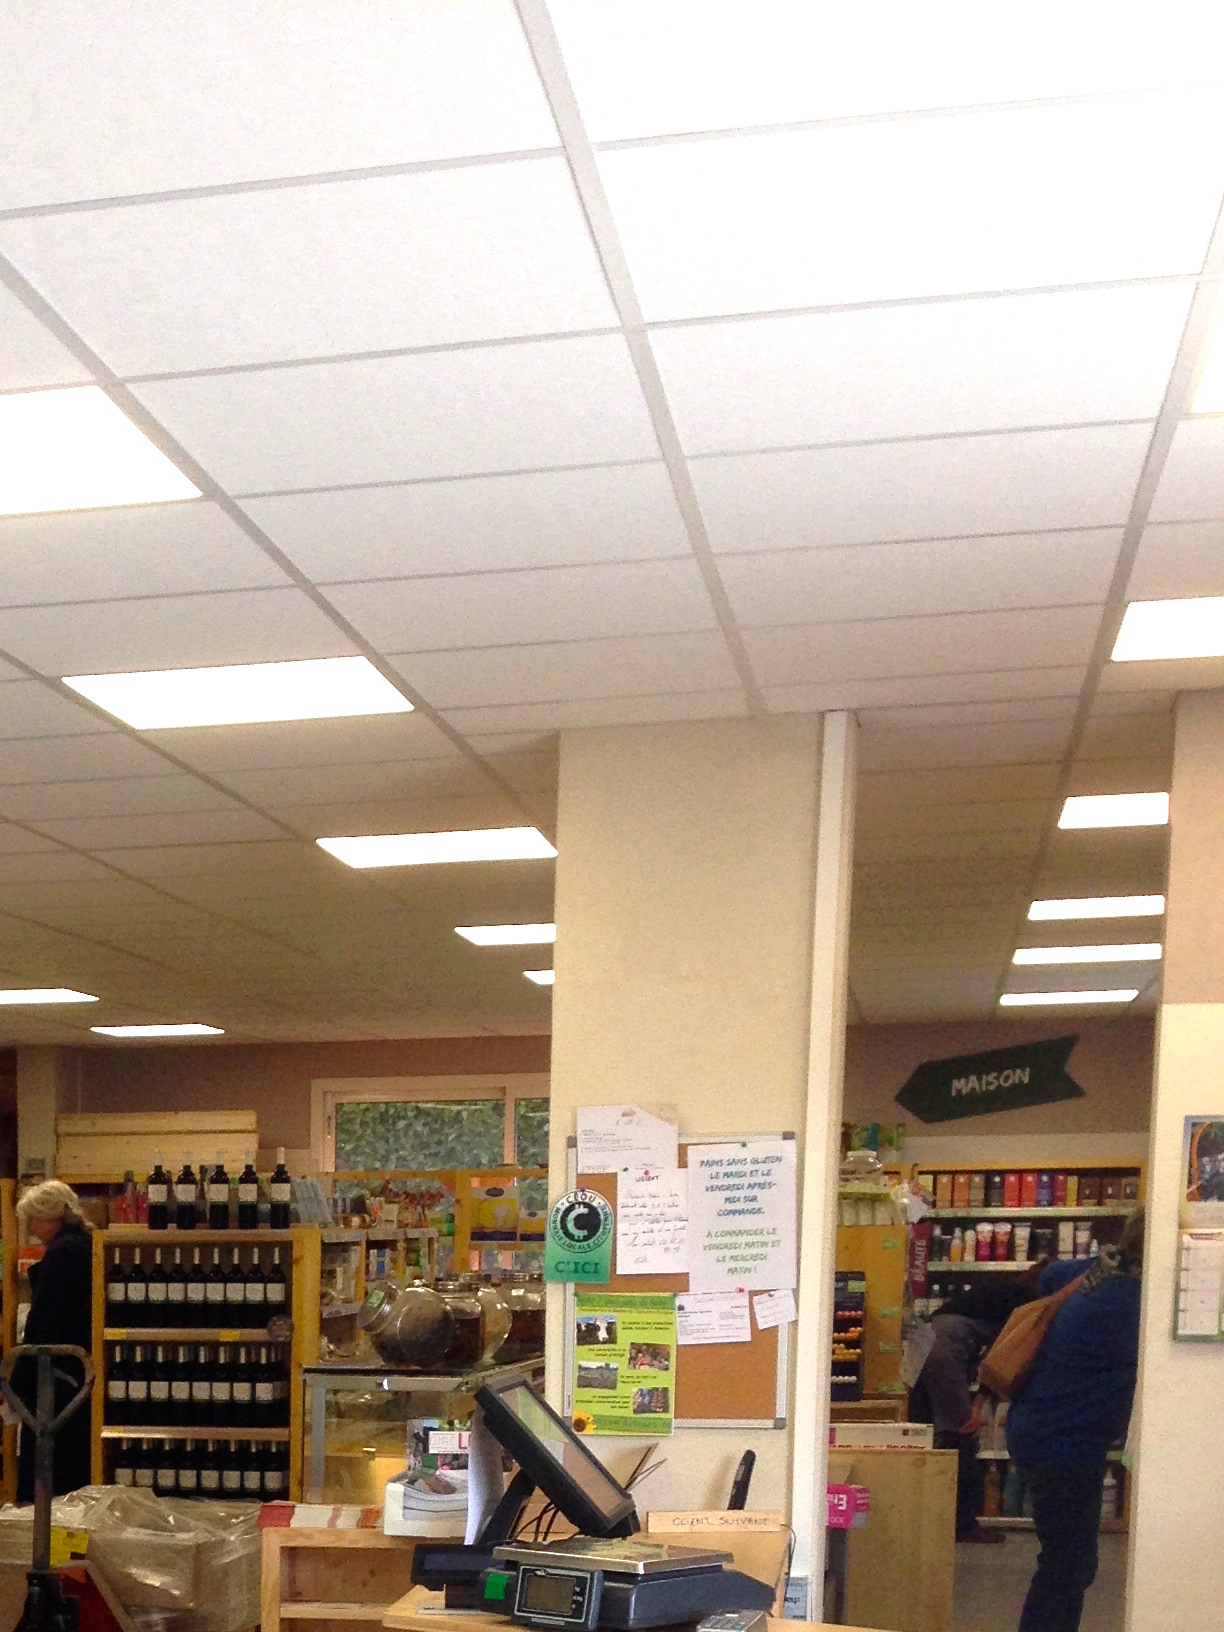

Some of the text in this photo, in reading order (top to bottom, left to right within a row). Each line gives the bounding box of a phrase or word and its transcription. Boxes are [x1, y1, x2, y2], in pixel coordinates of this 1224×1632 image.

[951, 1068, 1030, 1097] MAISON
[700, 1155, 782, 1167] PAINS SANS GLUTEN
[705, 1183, 745, 1192] VENDREDI
[672, 1517, 770, 1527] CLIENT SUIVANT
